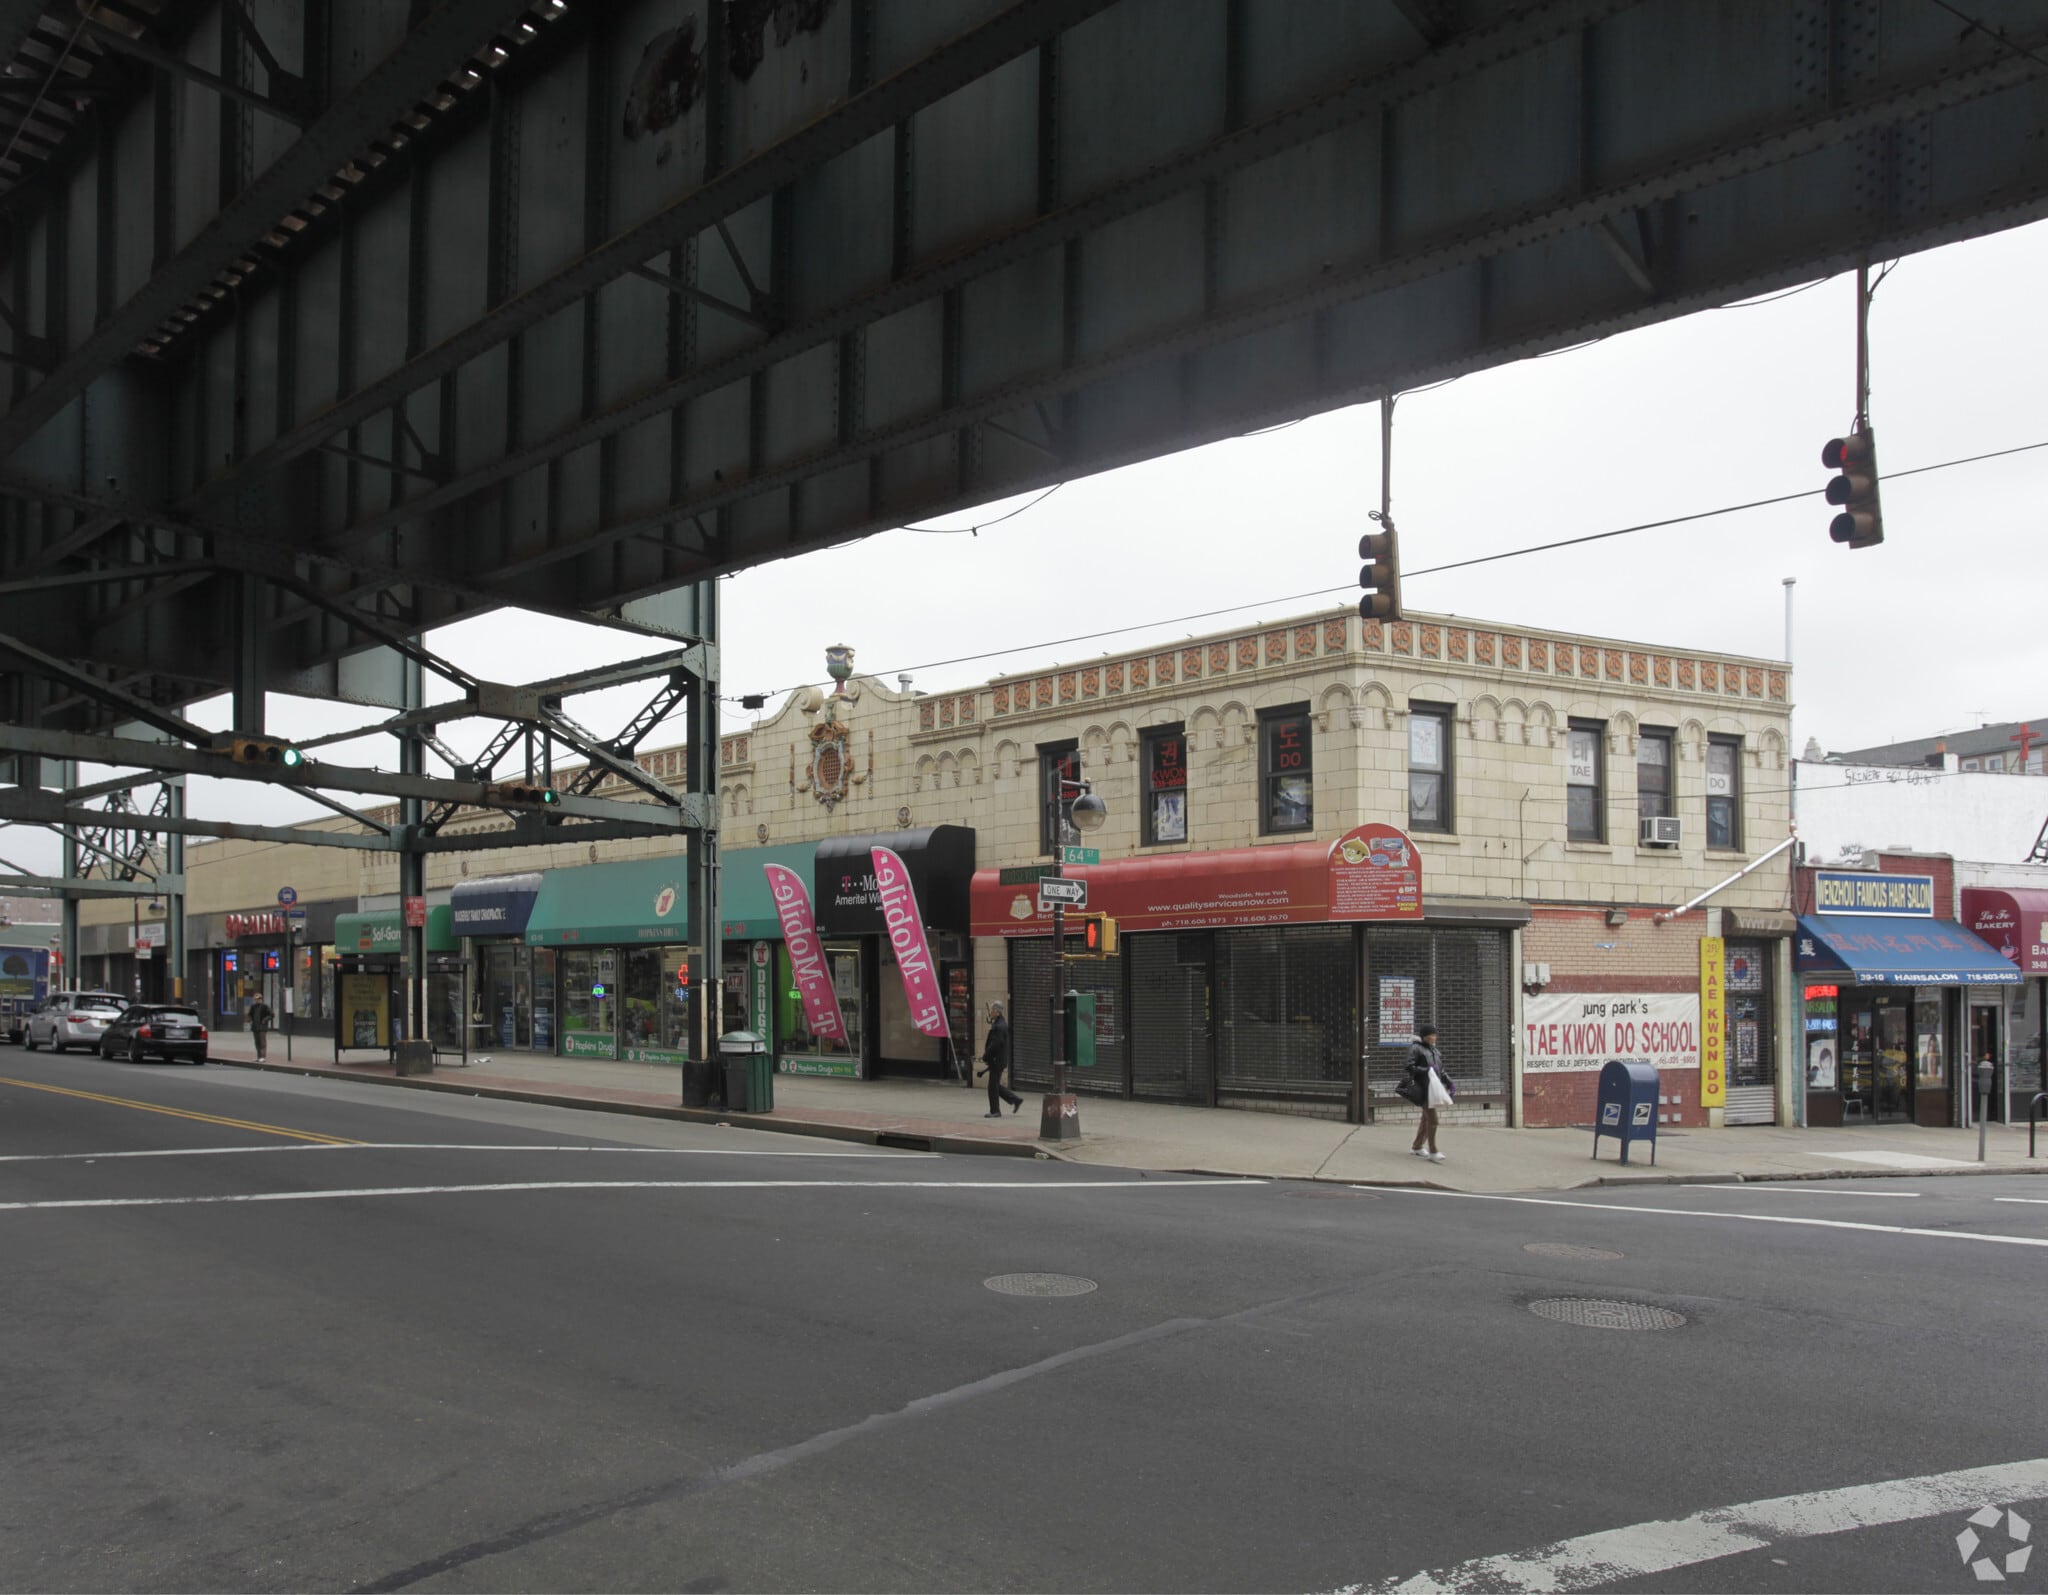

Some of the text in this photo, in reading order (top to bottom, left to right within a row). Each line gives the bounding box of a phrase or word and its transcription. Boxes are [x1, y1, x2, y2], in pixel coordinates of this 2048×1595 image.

[1280, 752, 1302, 768] DO
[1152, 767, 1187, 781] KWON
[1570, 765, 1592, 777] TAE
[1709, 778, 1726, 789] DO
[1069, 849, 1084, 862] 64
[1047, 885, 1080, 896] ONE WAY
[1818, 879, 1930, 909] WENZHOU FAMOUS HAIR SALON
[835, 893, 867, 906] Ameritel
[1148, 896, 1289, 912] www.qualityservicesnow.com
[1975, 922, 2015, 930] BAKERY
[1894, 973, 1959, 981] HAIRSALON
[758, 968, 766, 1038] DRUGS
[1582, 999, 1648, 1018] jung park's
[1707, 961, 1719, 1095] TAE KWON DO
[1527, 1021, 1697, 1056] TAE KWON DO SCHOOL
[575, 1040, 597, 1053] Hopkins
[1527, 1059, 1554, 1068] RESPECT
[1557, 1059, 1571, 1067] SELF
[1574, 1058, 1599, 1067] DEFENSE
